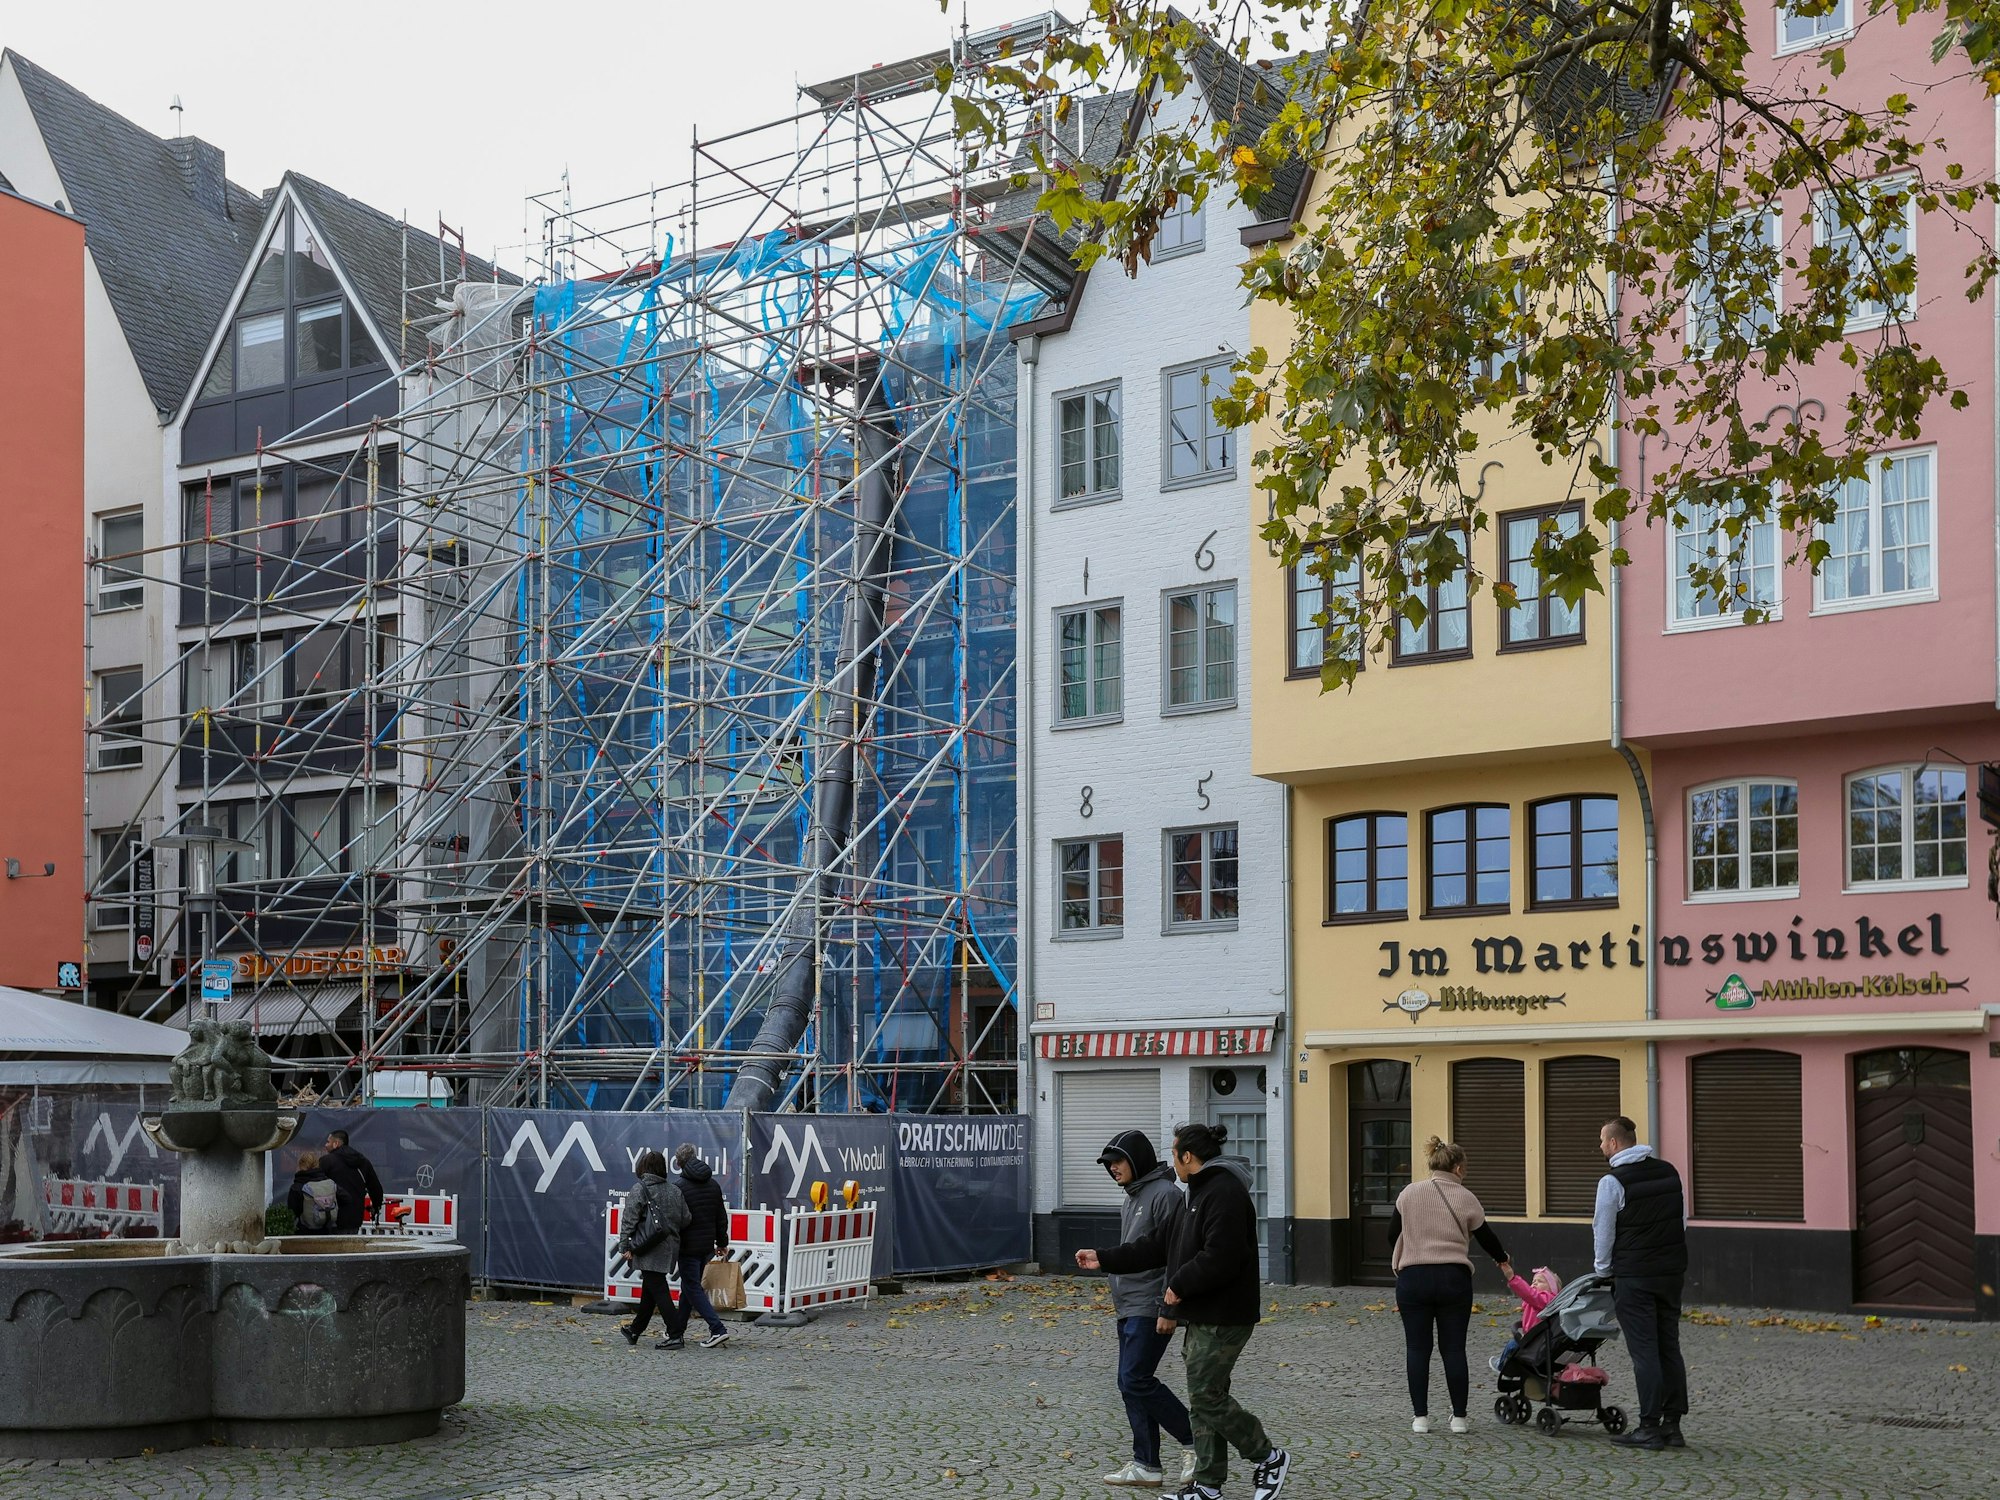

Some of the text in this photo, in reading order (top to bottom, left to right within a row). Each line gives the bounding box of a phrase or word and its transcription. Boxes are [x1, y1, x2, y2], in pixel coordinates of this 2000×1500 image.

[1195, 530, 1218, 571] 6
[1080, 770, 1213, 818] 8 5
[139, 860, 151, 929] SONDRBAR
[1472, 913, 1950, 976] Martinswinkel
[1439, 985, 1551, 1016] Bitburger
[1761, 976, 1856, 1001] Mühlen
[1861, 971, 1948, 996] Kölsch
[1059, 1038, 1088, 1055] Eis
[1133, 1036, 1165, 1053] Eis
[1216, 1034, 1247, 1051] Eis
[1414, 1054, 1422, 1067] 7
[899, 1122, 1024, 1152] DRATSCHMIDT.DE
[838, 1144, 886, 1173] YModul
[899, 1156, 931, 1168] ABBRUCH
